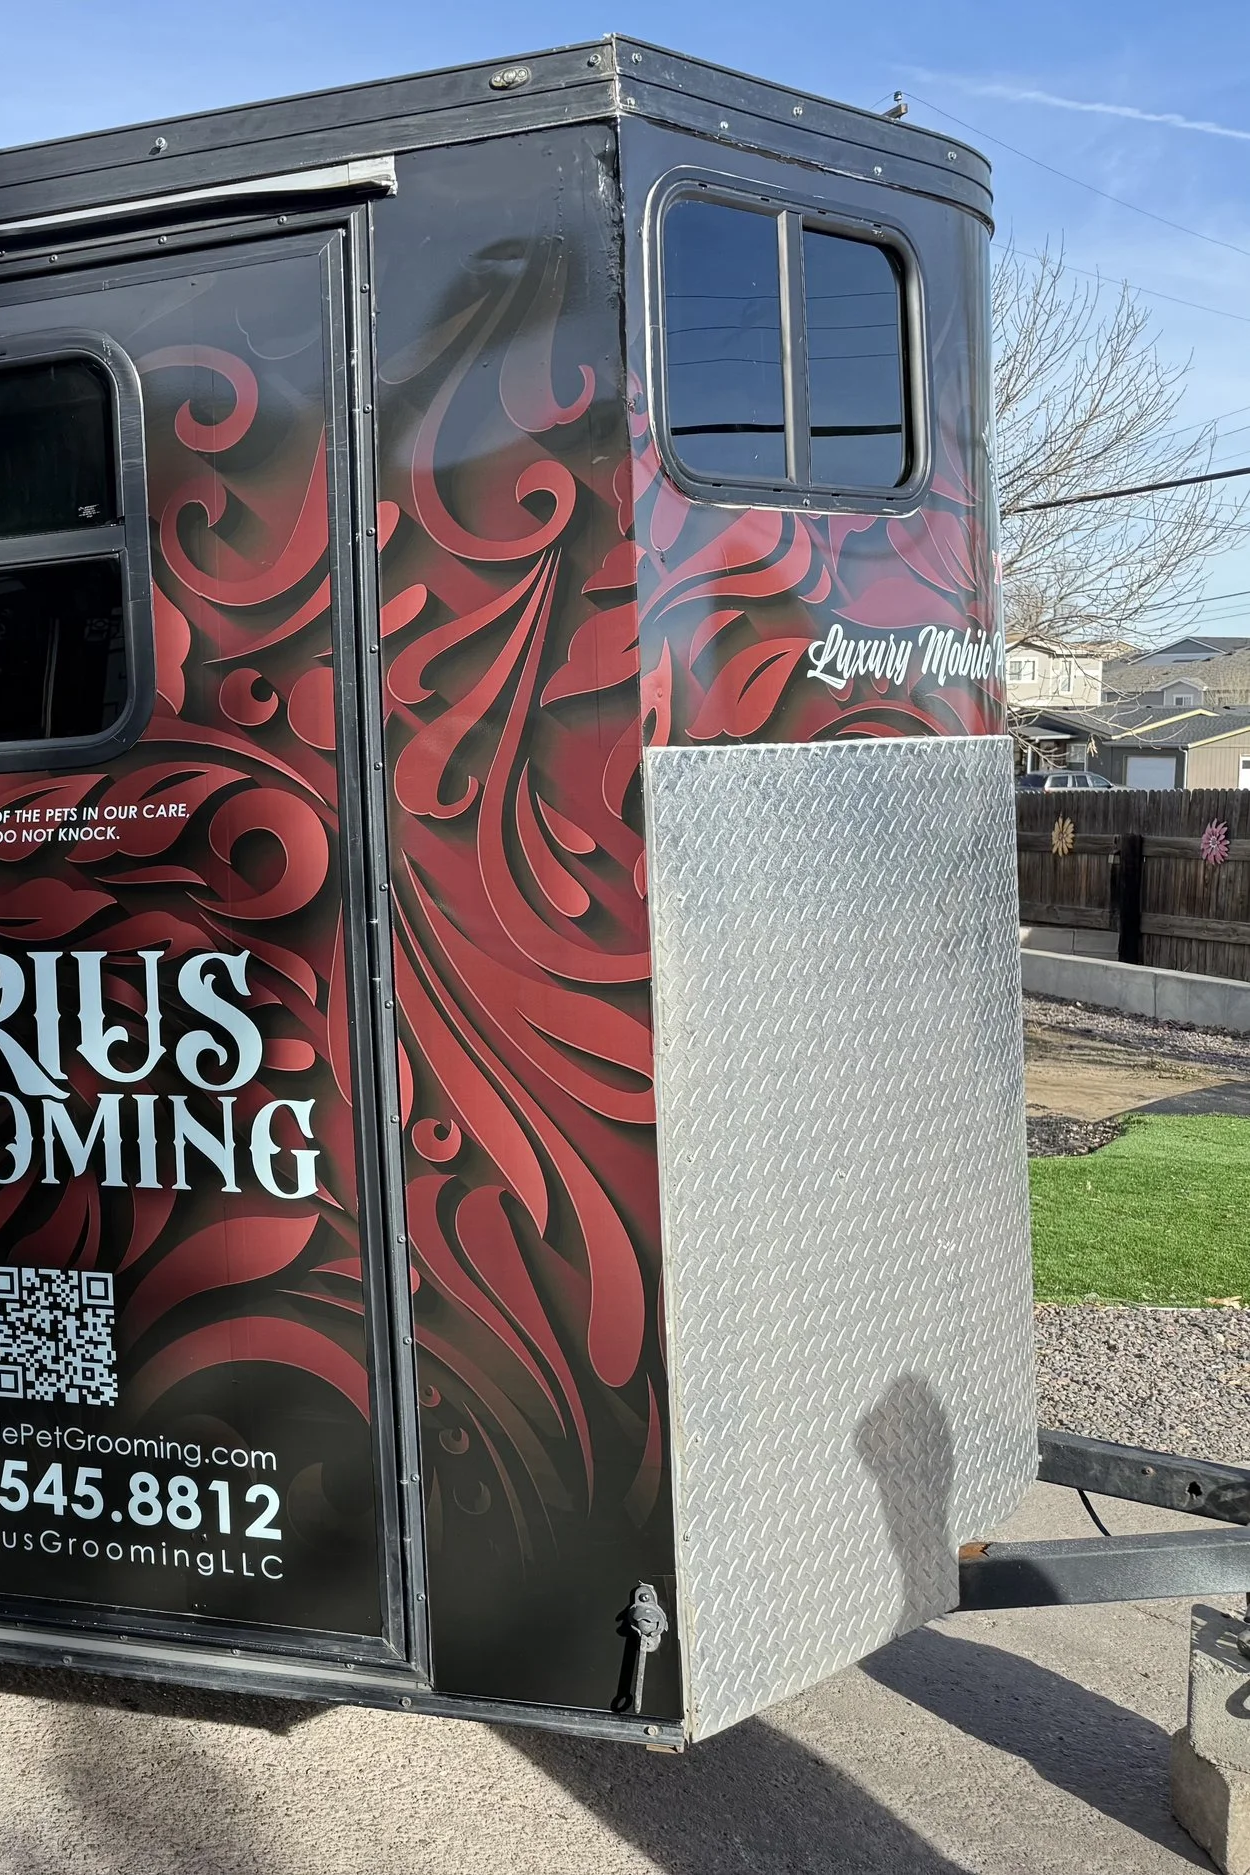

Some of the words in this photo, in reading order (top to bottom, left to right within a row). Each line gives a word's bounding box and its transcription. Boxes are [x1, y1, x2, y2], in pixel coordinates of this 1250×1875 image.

[807, 623, 913, 690] Luxury
[918, 625, 992, 687] Mobile
[15, 809, 41, 823] THE
[45, 807, 78, 822] PETS
[82, 806, 99, 820] IN
[103, 805, 138, 820] OUR
[142, 803, 191, 819] CARE,
[21, 828, 54, 843] NOT
[58, 826, 120, 842] KNOCK.
